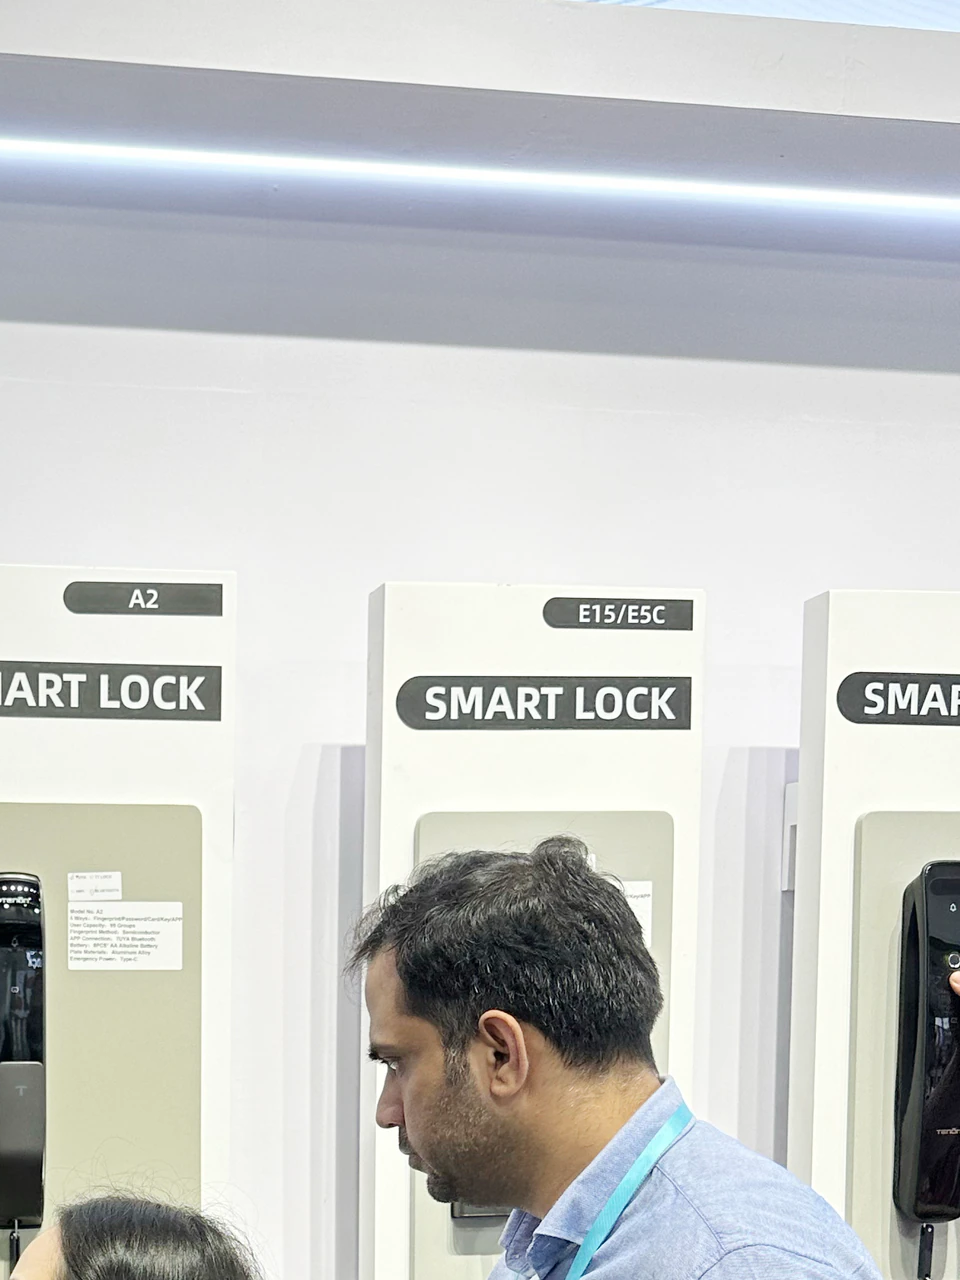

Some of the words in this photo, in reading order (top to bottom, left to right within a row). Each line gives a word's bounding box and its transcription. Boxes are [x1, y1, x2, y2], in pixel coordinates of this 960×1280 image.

[128, 588, 159, 609] A2
[578, 604, 666, 624] E15/E5C
[99, 673, 206, 711] LOCK
[425, 686, 564, 720] SMART
[575, 686, 677, 720] LOCK
